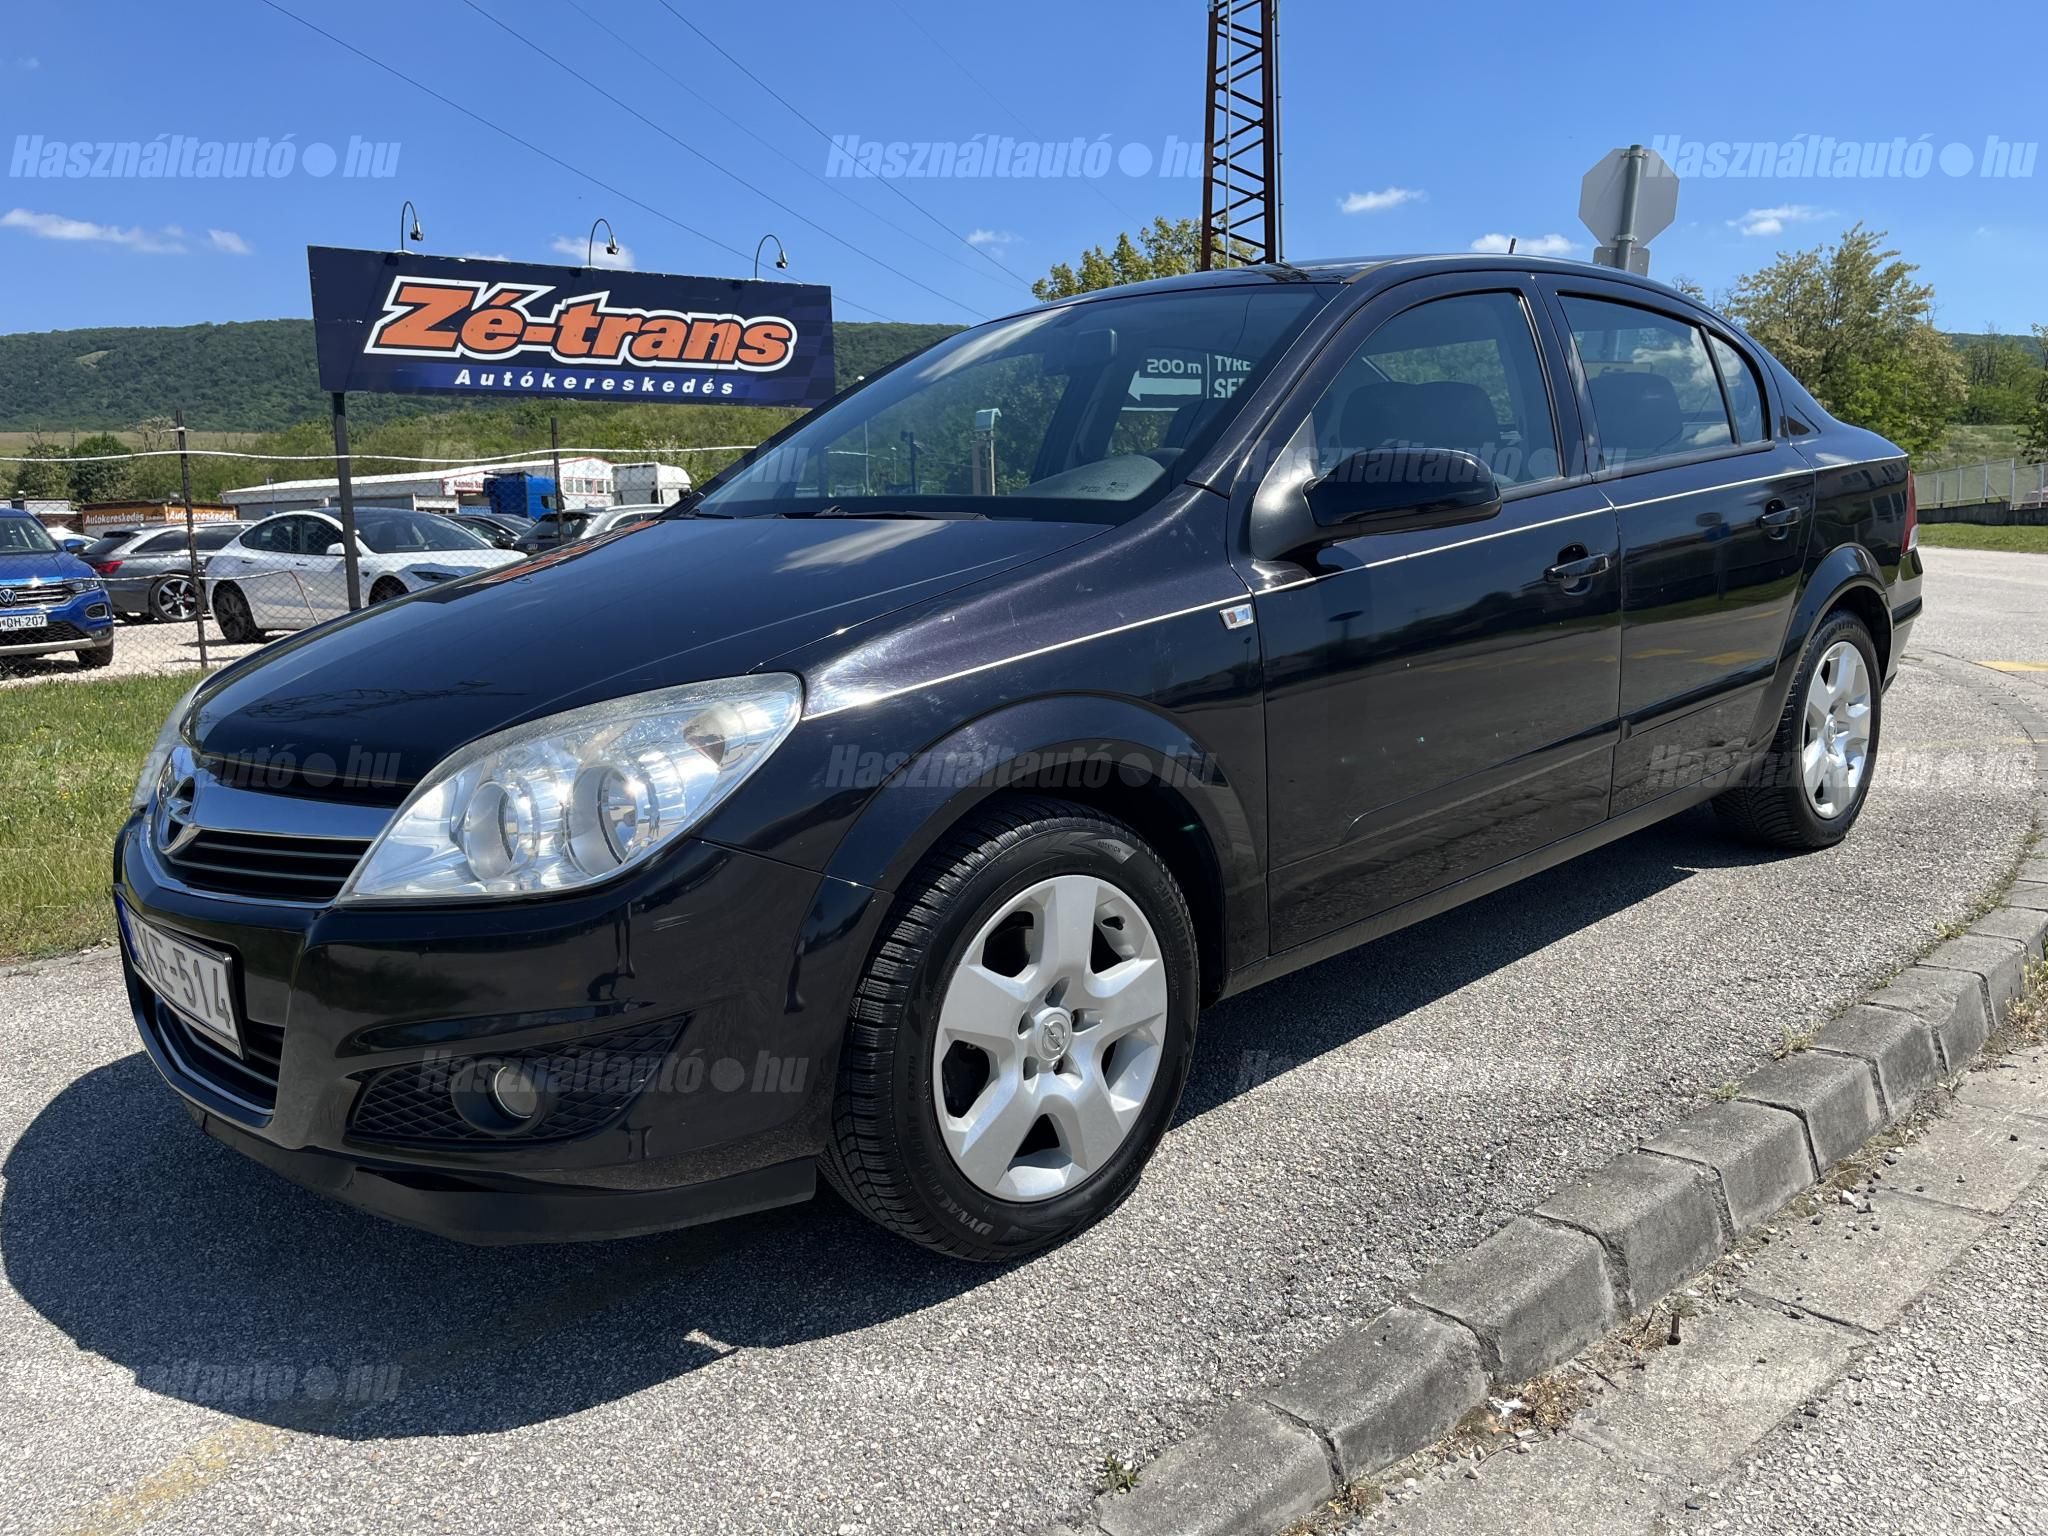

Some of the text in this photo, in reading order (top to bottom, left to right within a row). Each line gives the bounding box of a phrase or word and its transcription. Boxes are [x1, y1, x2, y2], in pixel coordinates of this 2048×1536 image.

[375, 282, 793, 368] Zé-trans
[1146, 359, 1185, 373] 200
[1214, 355, 1252, 372] TYRE
[455, 368, 733, 395] Autókereskedés
[1213, 378, 1246, 399] SE
